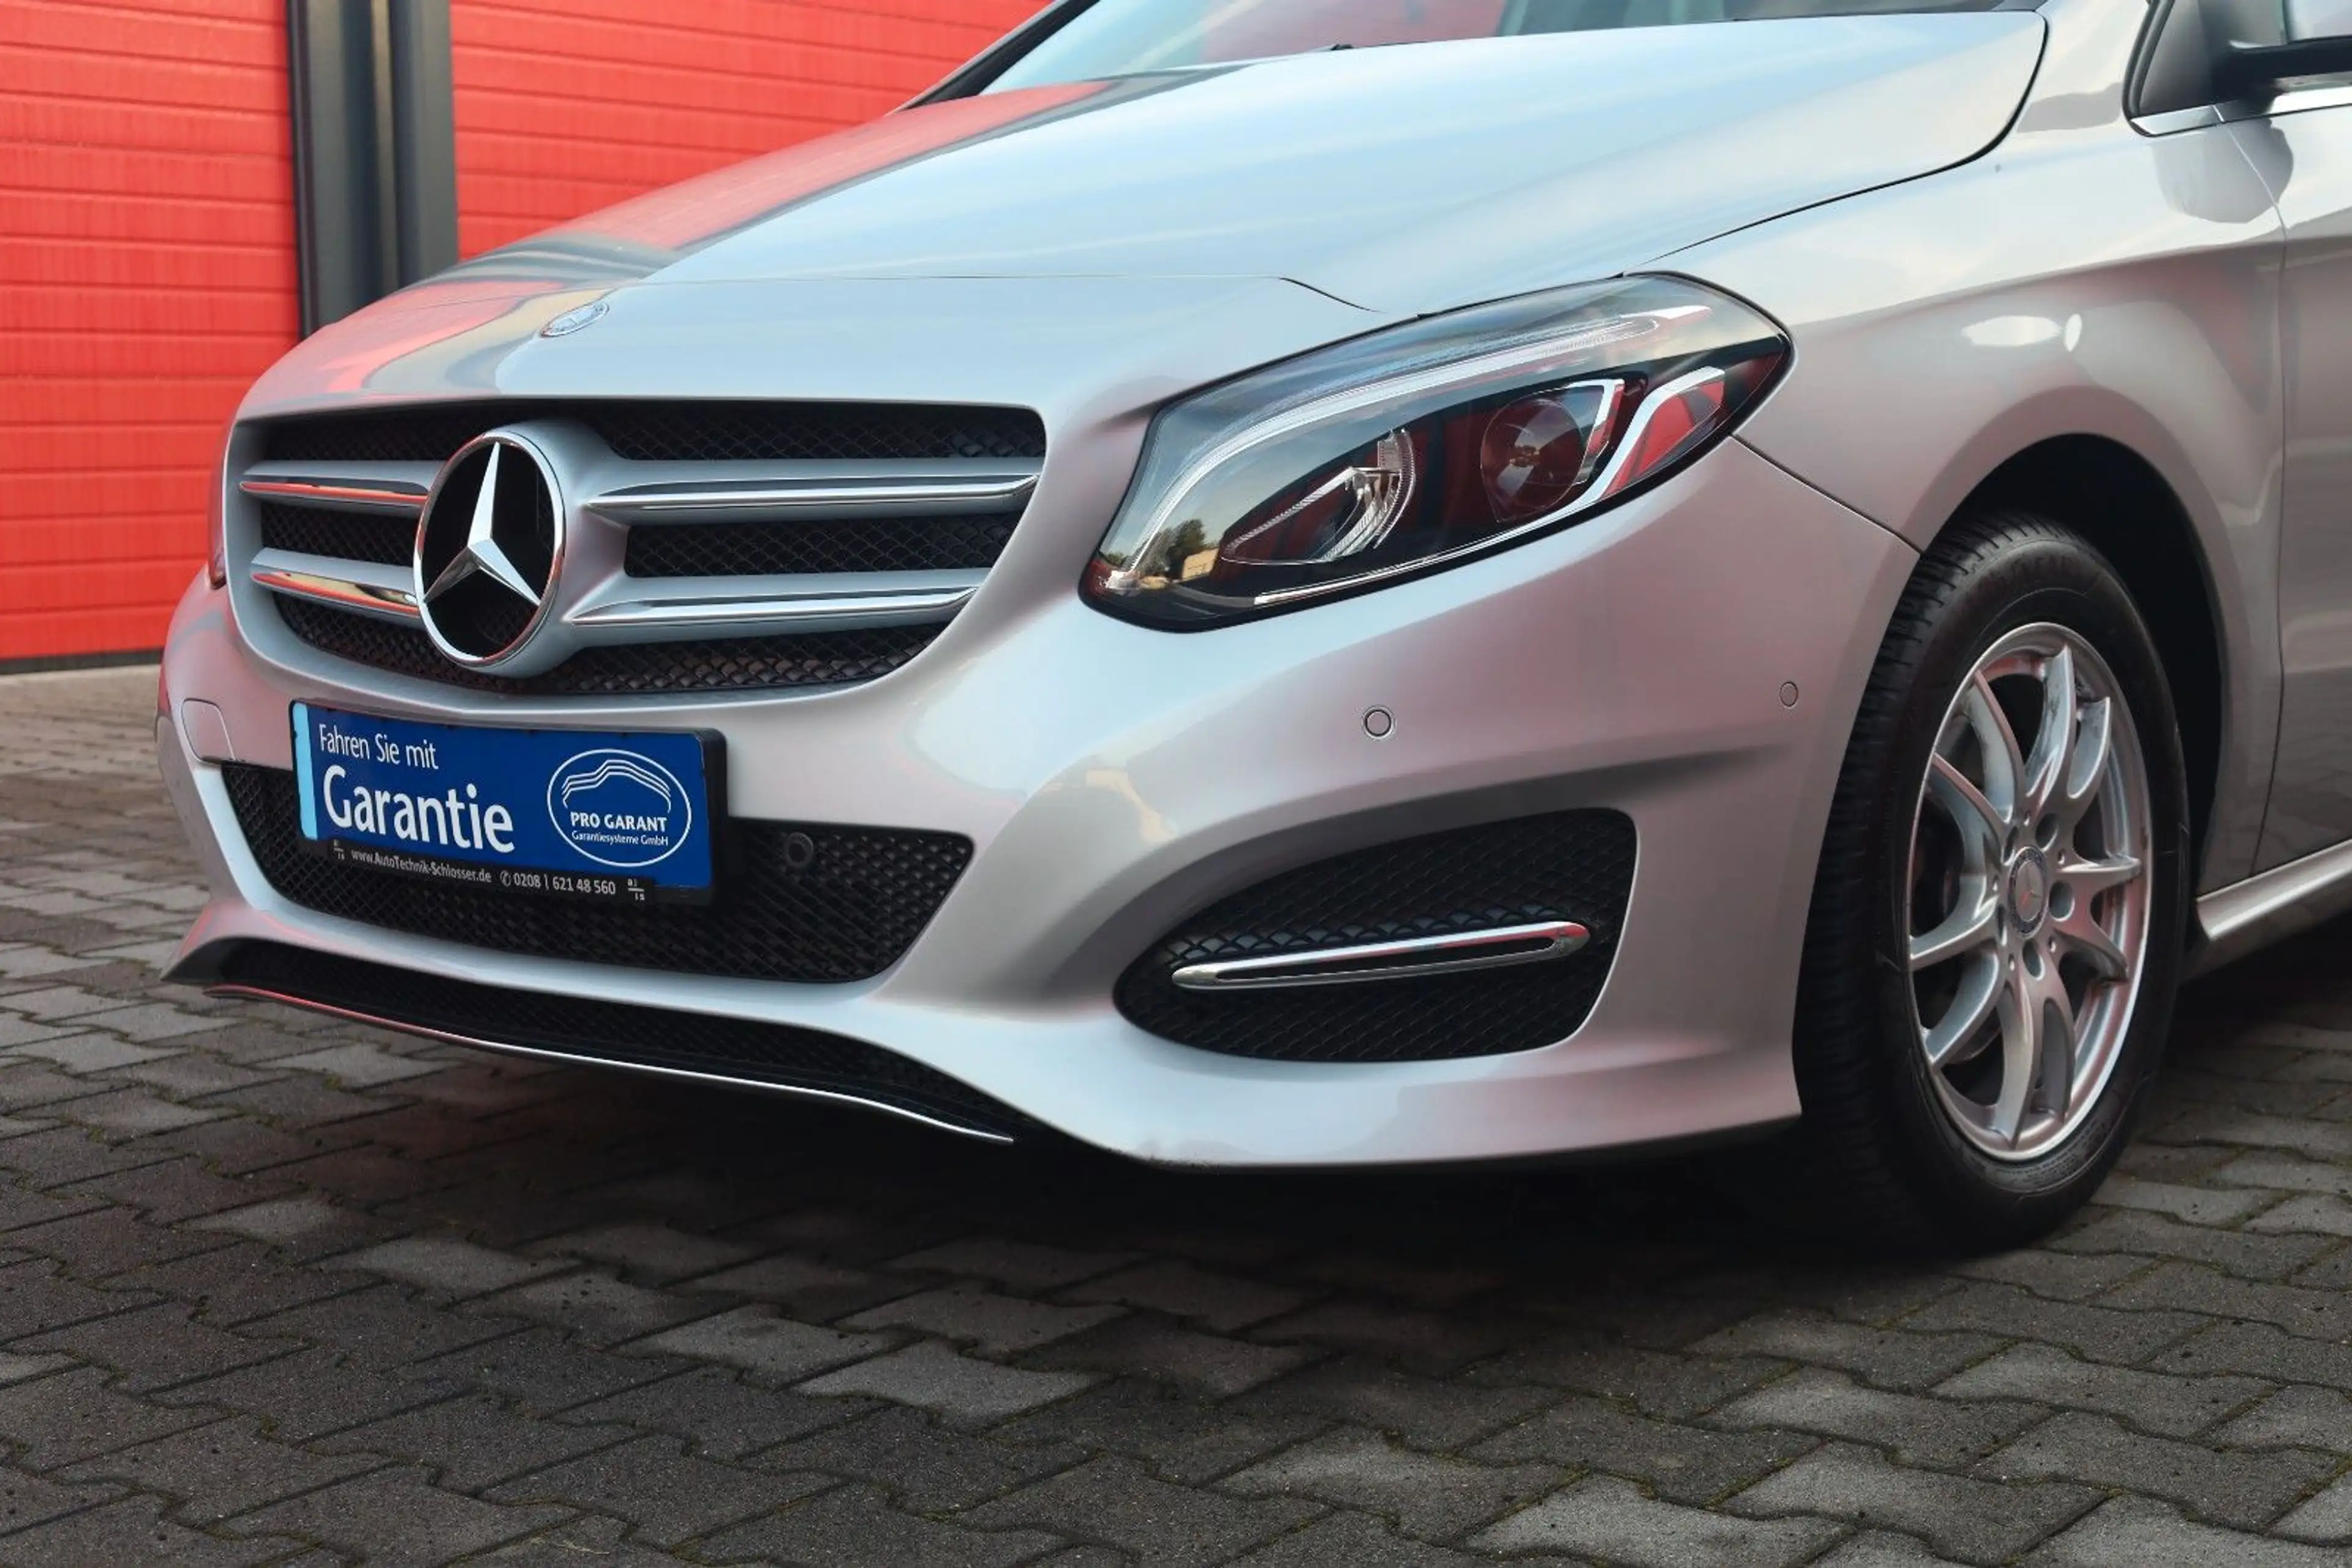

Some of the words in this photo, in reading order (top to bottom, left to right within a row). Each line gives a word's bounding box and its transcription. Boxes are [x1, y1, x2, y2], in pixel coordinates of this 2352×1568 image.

[318, 723, 371, 760] Fahren
[375, 733, 401, 764] Sie
[405, 739, 439, 769] mit
[323, 764, 515, 853] Garantie
[570, 811, 600, 828] PRO
[604, 814, 668, 832] GARANT
[571, 830, 639, 846] Garantiesysteme
[641, 834, 669, 846] GmbH
[513, 872, 542, 888] 0208
[552, 876, 575, 892] 621
[576, 878, 592, 893] 48
[594, 880, 616, 895] 560
